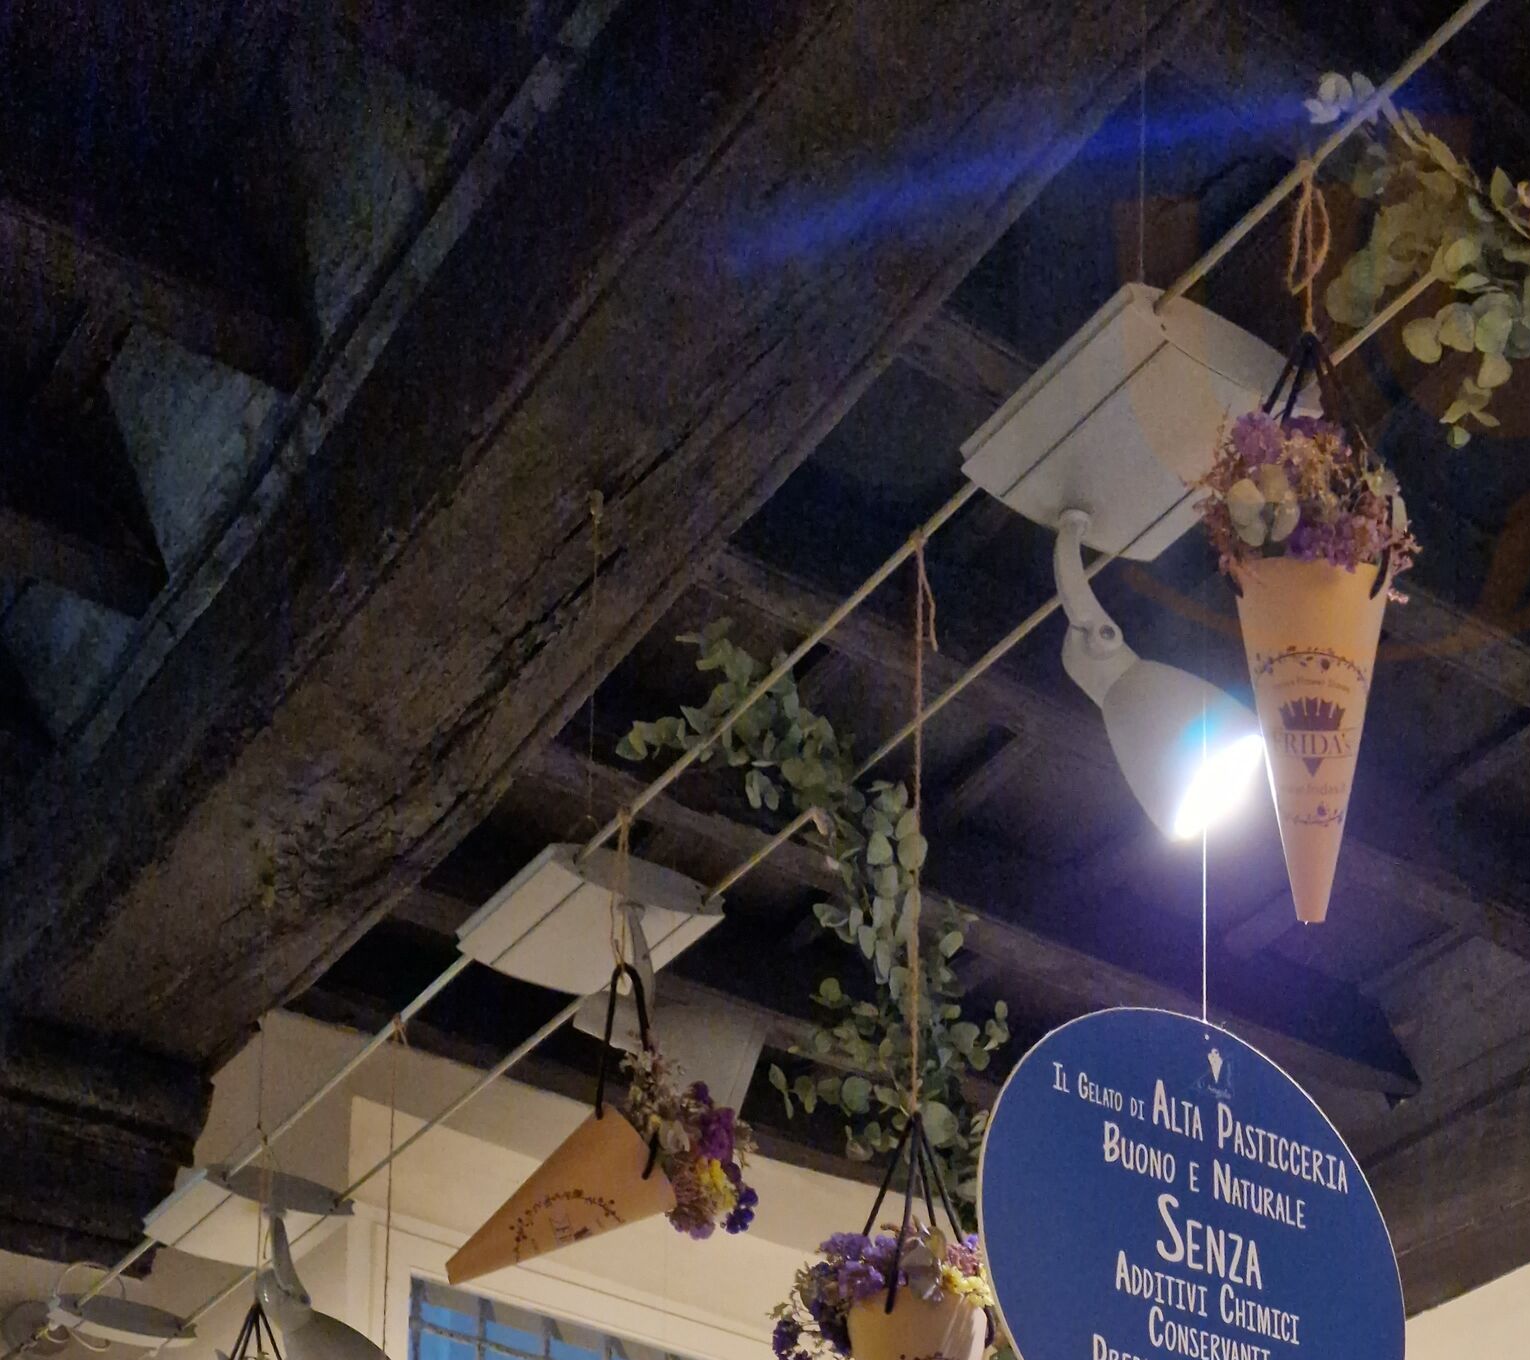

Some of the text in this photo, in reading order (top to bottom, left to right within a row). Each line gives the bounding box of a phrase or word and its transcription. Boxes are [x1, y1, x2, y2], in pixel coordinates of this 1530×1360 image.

[1103, 1121, 1175, 1184] BUONO
[1214, 1159, 1306, 1229] NATURALE
[1152, 1080, 1203, 1140] ALTA
[1217, 1102, 1348, 1194] PASTICCERIA
[1156, 1194, 1262, 1289] SENZA
[1116, 1250, 1299, 1345] ADDITIVI CHIMICI
